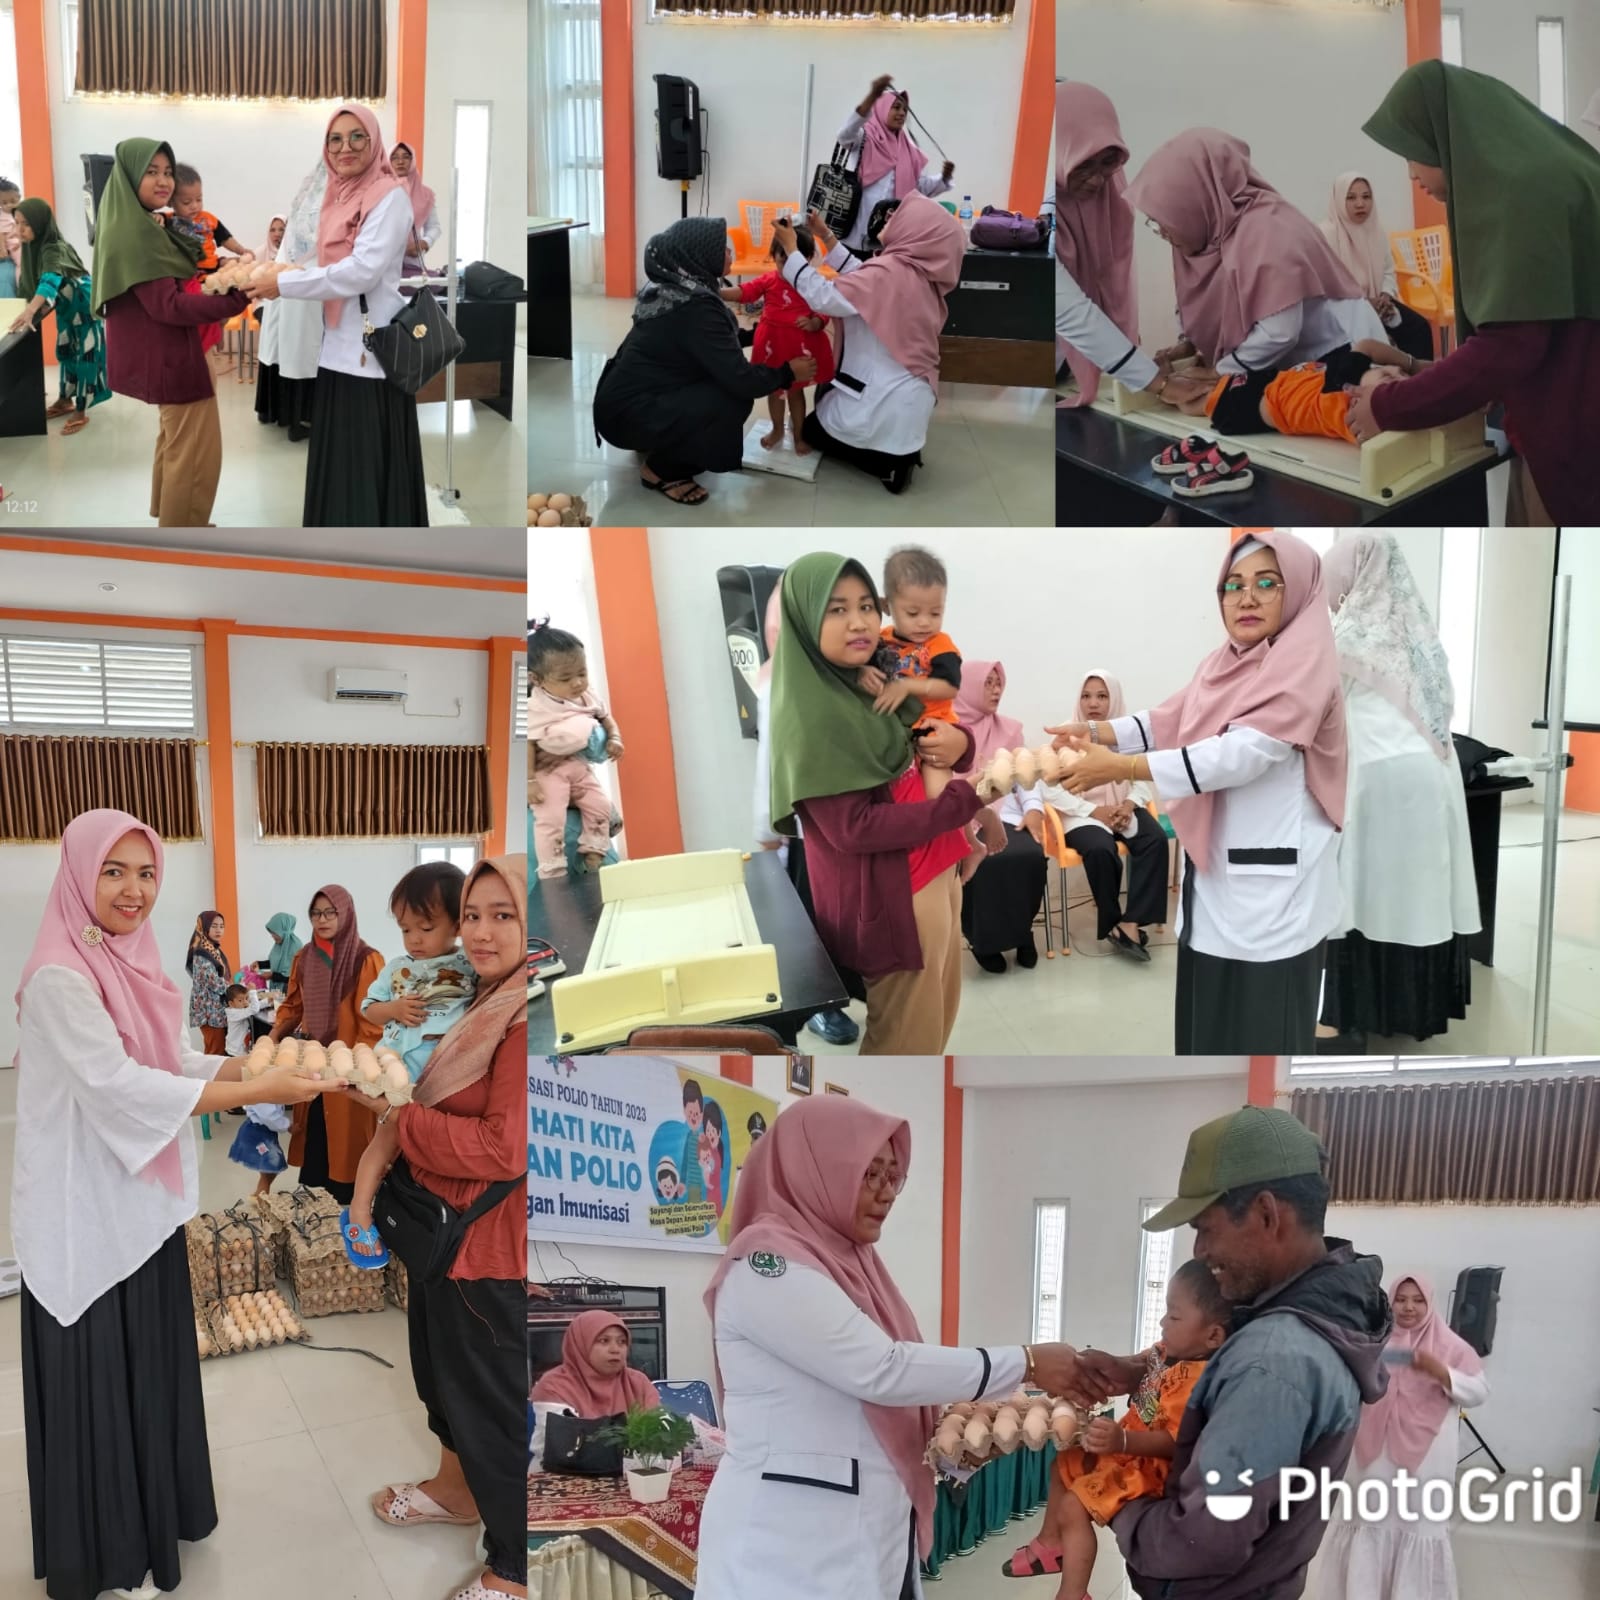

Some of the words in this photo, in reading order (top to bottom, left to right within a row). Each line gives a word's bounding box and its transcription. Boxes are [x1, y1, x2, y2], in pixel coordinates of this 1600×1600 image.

[557, 1084, 588, 1107] POLIO
[590, 1093, 623, 1116] TAHUN
[625, 1103, 647, 1122] 2023
[531, 1106, 585, 1143] HATI
[590, 1120, 636, 1154] KITA
[527, 1143, 562, 1180] AN
[570, 1151, 642, 1192] POLIO
[559, 1192, 630, 1223] Imunisasi
